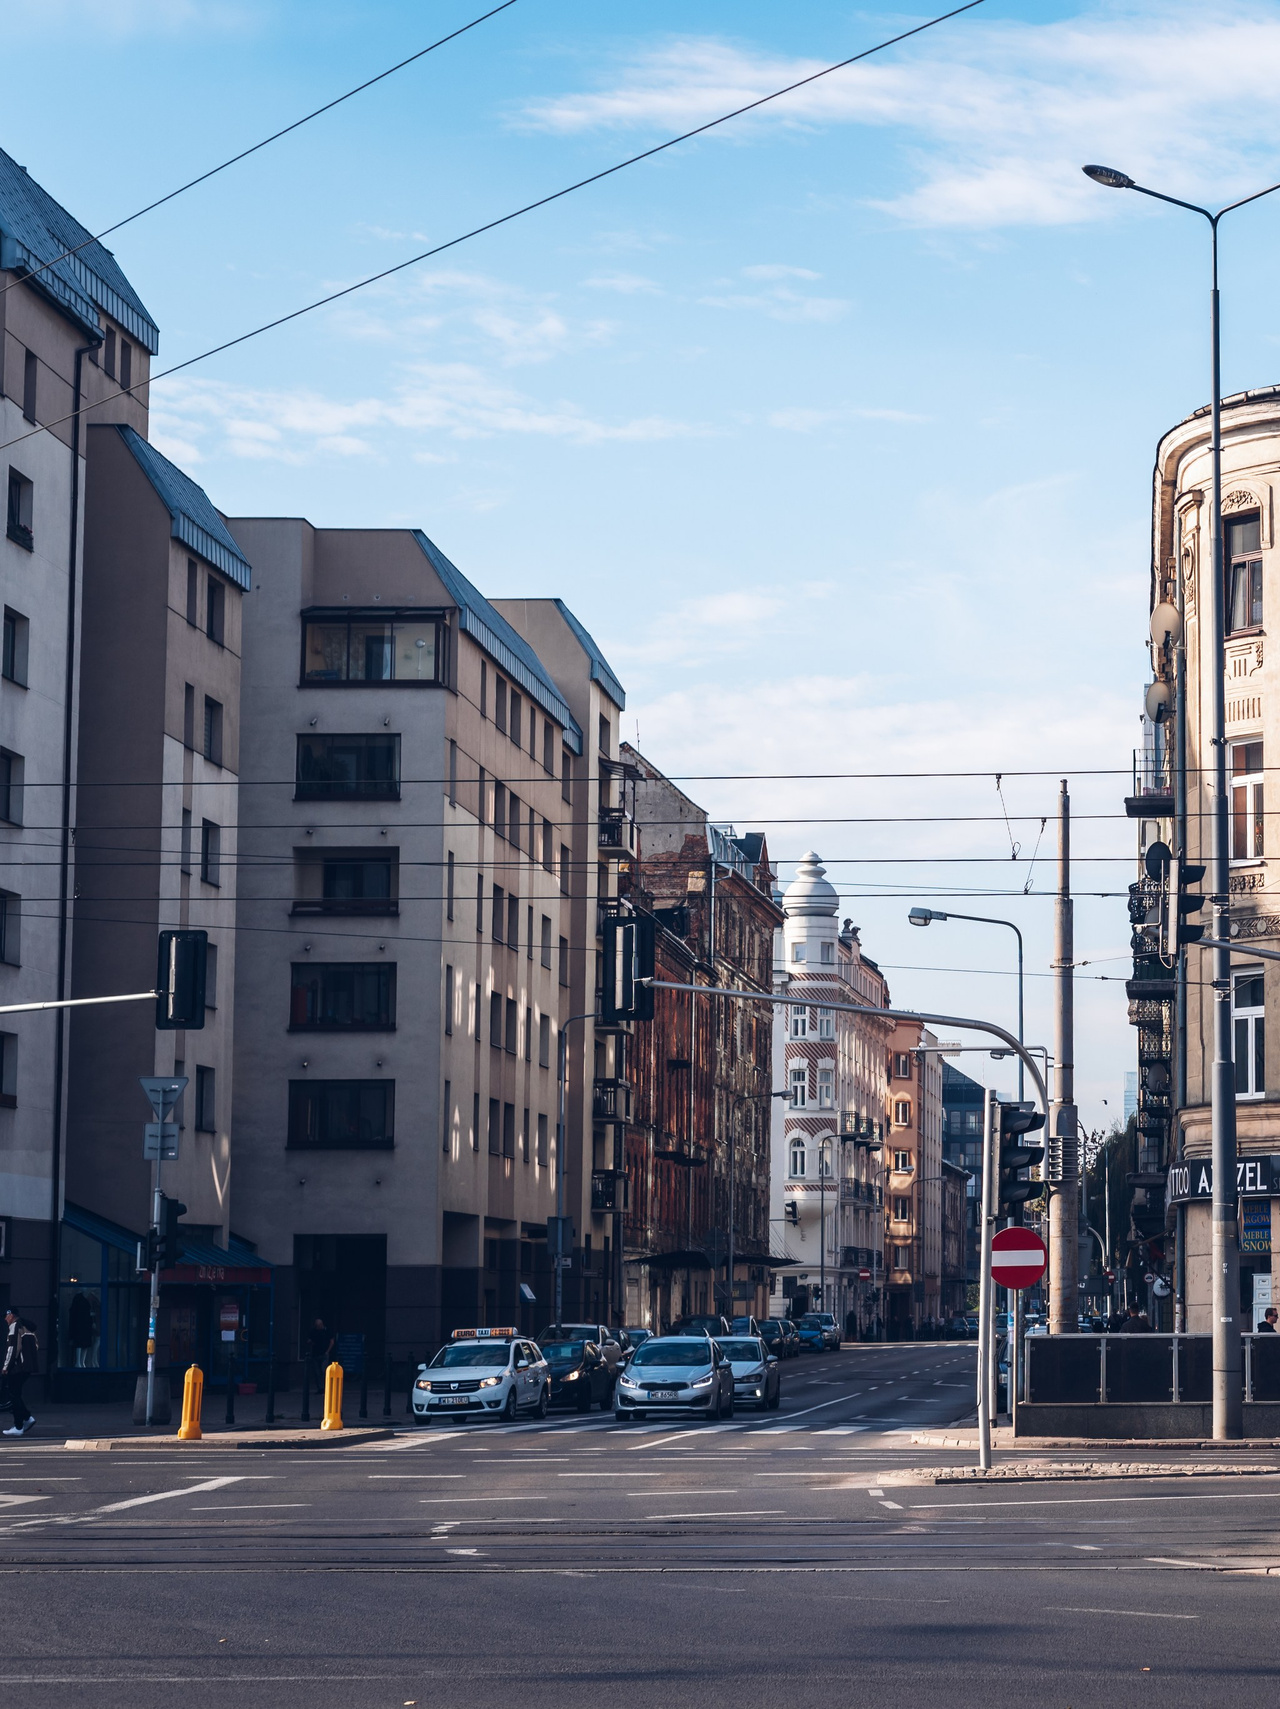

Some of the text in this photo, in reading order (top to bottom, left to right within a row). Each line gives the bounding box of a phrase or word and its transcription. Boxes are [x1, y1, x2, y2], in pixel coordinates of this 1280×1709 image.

[1198, 1162, 1267, 1193] AZEL
[1243, 1231, 1269, 1240] MEBLE
[456, 1329, 475, 1337] EURO
